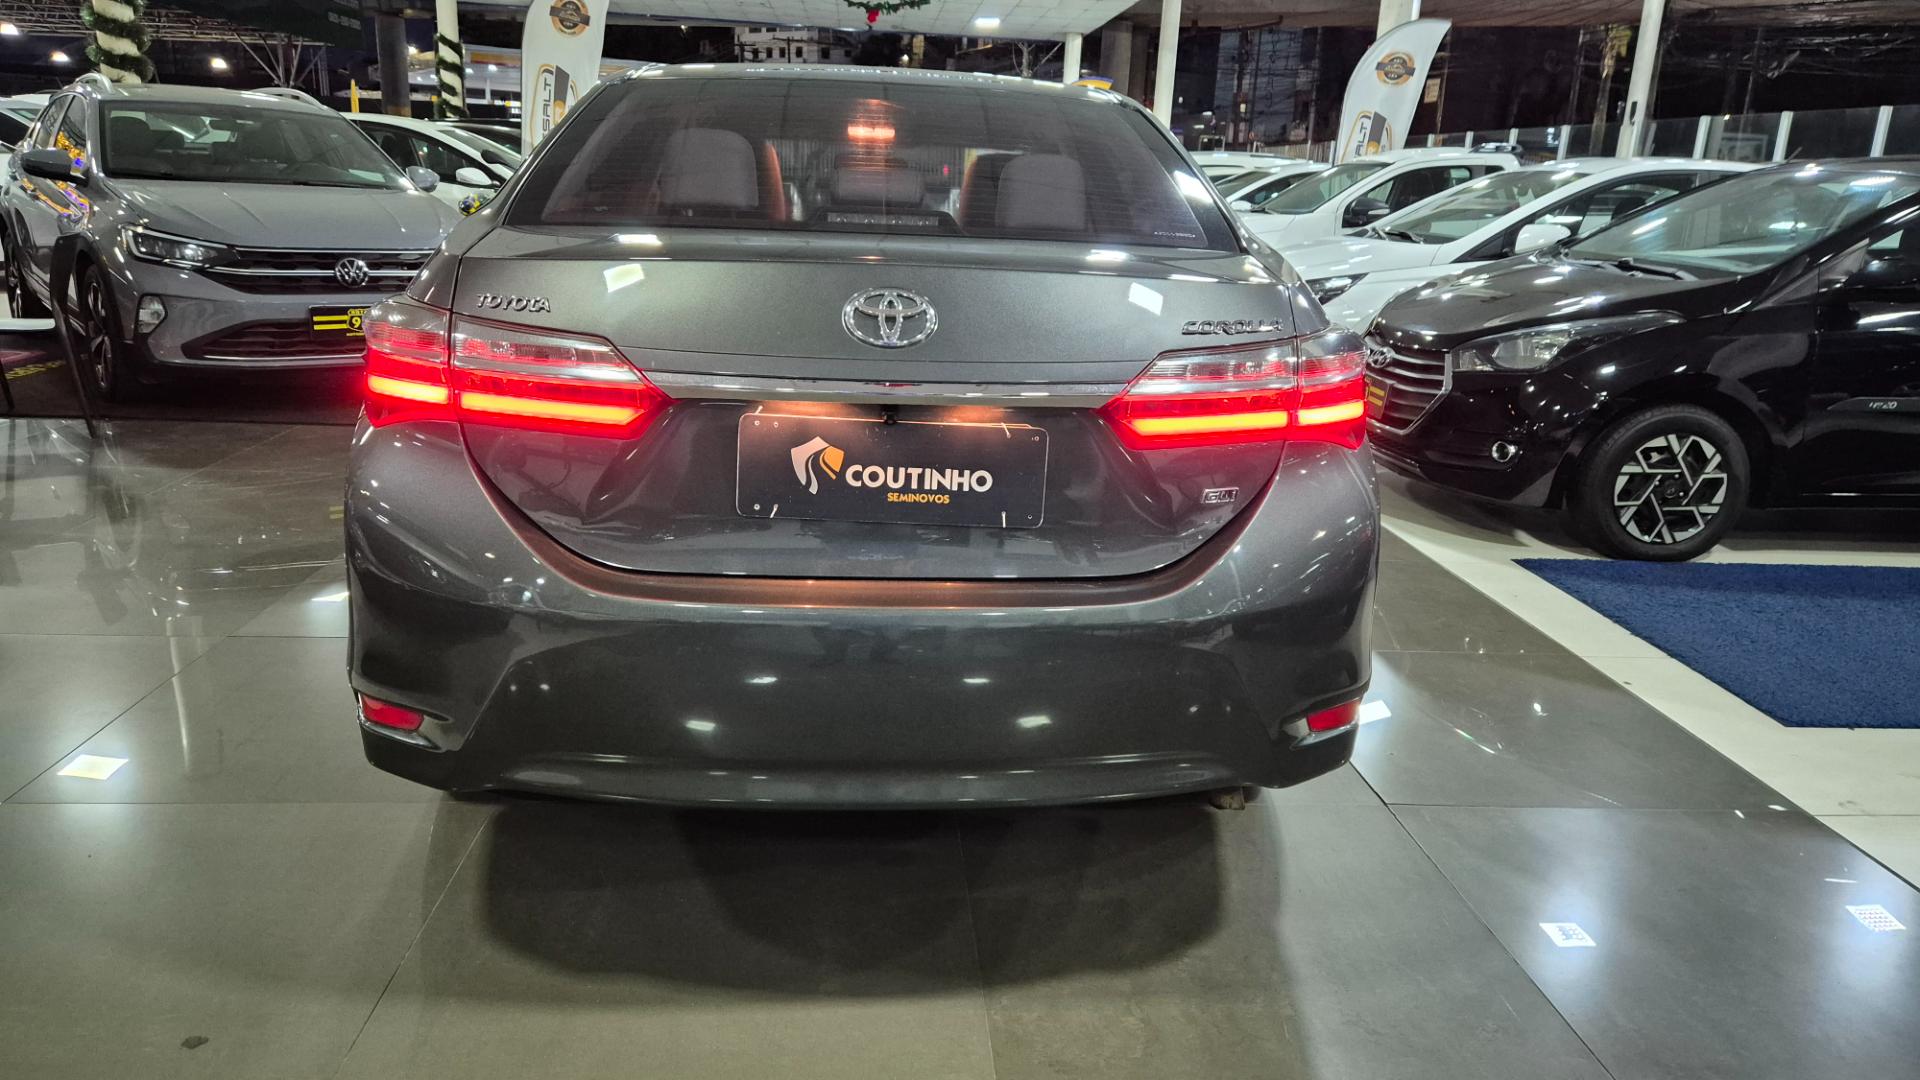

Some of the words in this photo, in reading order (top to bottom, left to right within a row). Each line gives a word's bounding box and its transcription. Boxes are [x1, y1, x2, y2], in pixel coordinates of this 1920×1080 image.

[542, 77, 552, 138] SALT
[1354, 121, 1368, 157] ALT
[477, 293, 551, 312] TOYOTA
[1182, 319, 1283, 335] COROLLA
[845, 464, 994, 493] COUTINHO
[887, 492, 950, 505] SEMINOVOS
